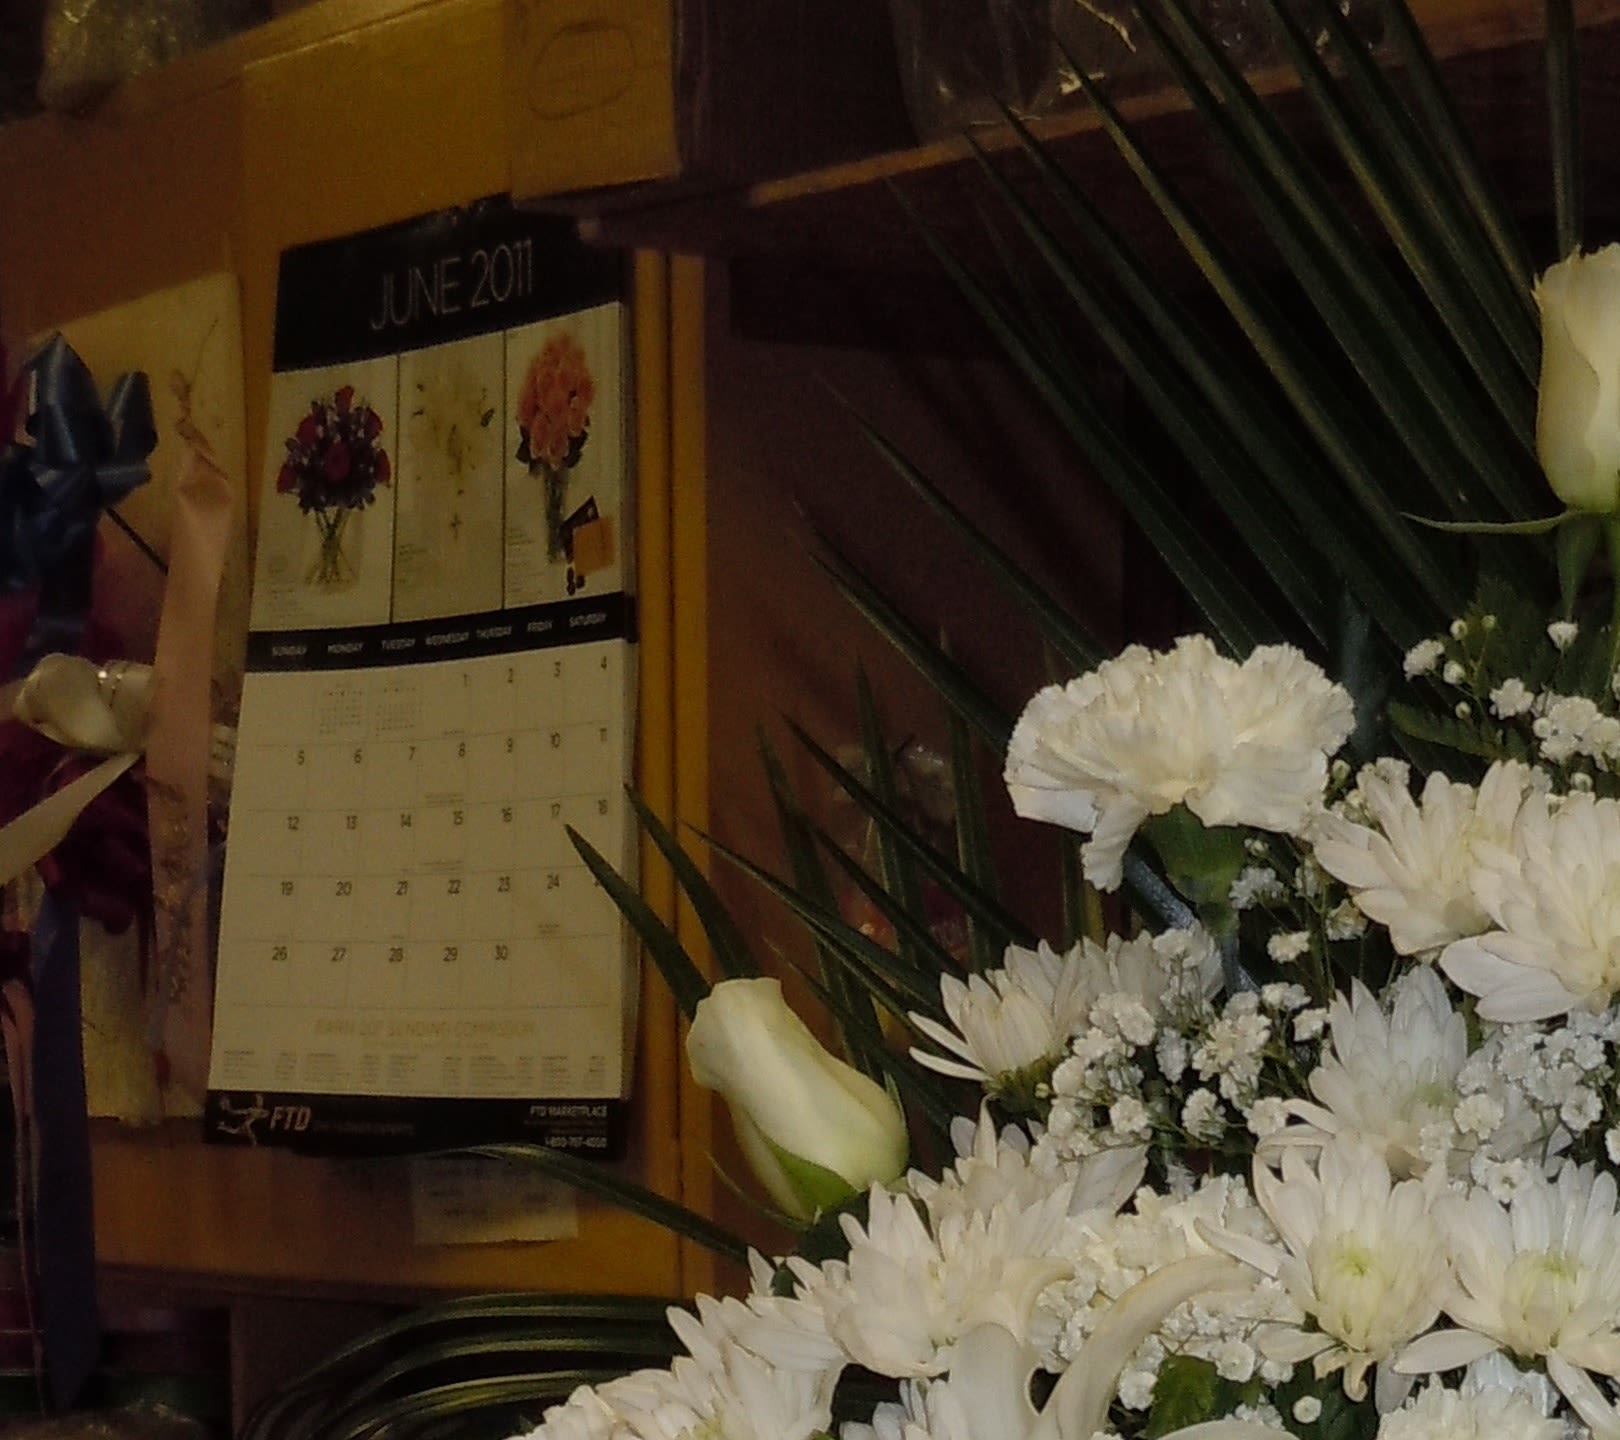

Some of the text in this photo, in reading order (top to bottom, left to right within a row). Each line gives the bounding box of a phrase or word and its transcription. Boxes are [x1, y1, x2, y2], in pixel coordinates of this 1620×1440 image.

[369, 236, 533, 331] JUNE 2011
[271, 612, 608, 658] SUNDAY MONDAY TUESDAY WEDNESDAY THURSDAY FRIDAY SATURDAY
[462, 655, 608, 687] 1 2 3 4
[297, 727, 608, 766] 5 6 7 8 9 10 11
[287, 798, 609, 832] 12 13 14 15 16 17 18
[280, 874, 560, 897] 19 20 21 22 23 24
[271, 944, 509, 963] 26 27 28 29 30
[270, 1105, 312, 1132] FTD
[548, 1104, 609, 1118] MARKETPLACE
